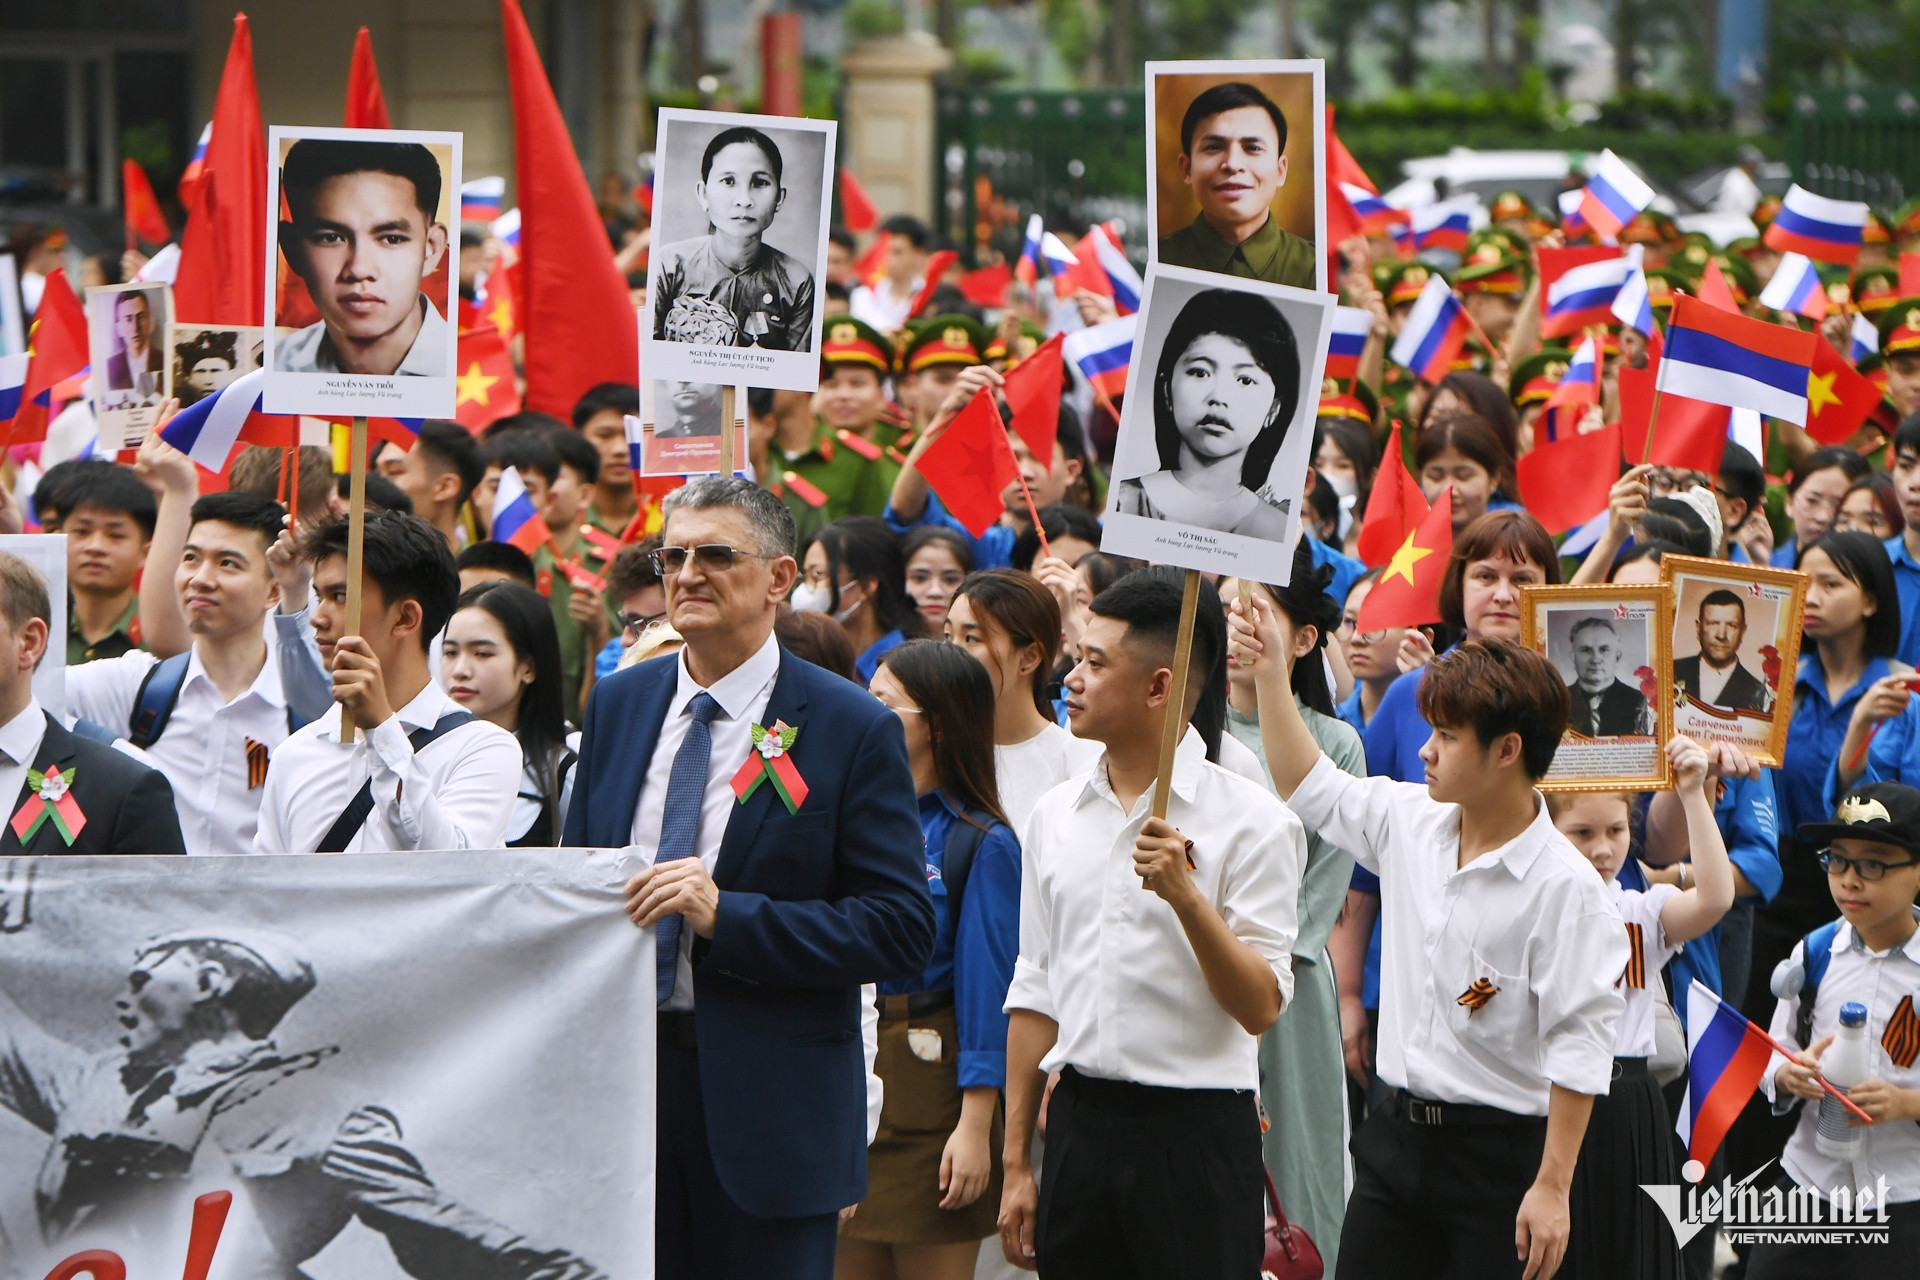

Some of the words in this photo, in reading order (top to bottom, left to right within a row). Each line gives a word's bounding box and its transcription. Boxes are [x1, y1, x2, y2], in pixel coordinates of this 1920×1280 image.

[720, 352, 731, 360] THỊ
[326, 379, 357, 388] NGUYỄN
[1178, 531, 1189, 539] VÕ
[1190, 533, 1202, 543] THỊ
[1203, 535, 1218, 544] SÁU
[1222, 550, 1239, 558] trang
[1688, 716, 1743, 733] Савченков
[1676, 728, 1701, 738] хаил
[1703, 731, 1766, 748] Гаврилович
